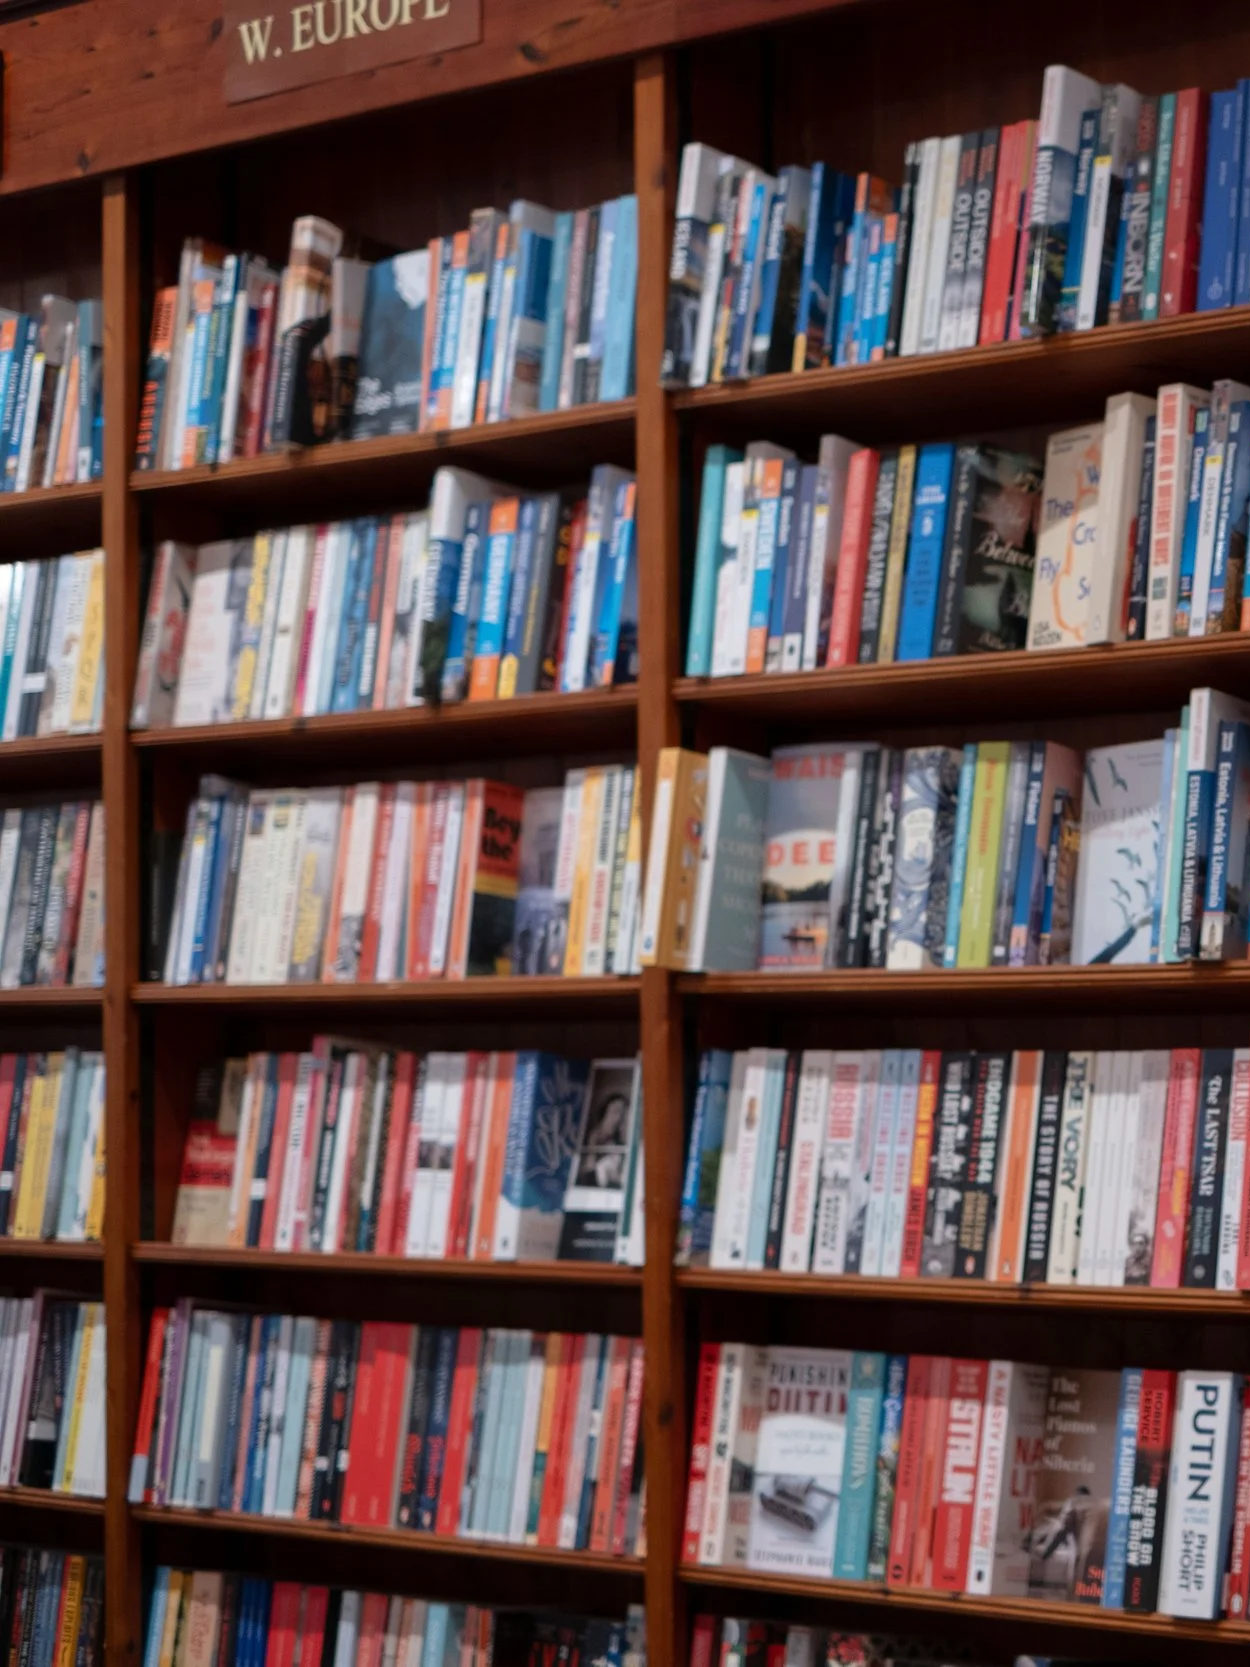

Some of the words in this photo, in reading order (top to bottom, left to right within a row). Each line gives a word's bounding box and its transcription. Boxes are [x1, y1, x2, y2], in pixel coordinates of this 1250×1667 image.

[238, 16, 283, 65] W.
[1029, 150, 1053, 225] NORWAY
[1024, 782, 1041, 825] Finland
[1037, 1126, 1056, 1175] STORY
[1060, 1116, 1083, 1192] VORY
[1202, 1108, 1221, 1153] LAST
[1198, 1153, 1220, 1197] TSAR
[1029, 1201, 1048, 1260] RUSSIA
[1187, 1384, 1219, 1501] PUTIN
[1114, 1435, 1137, 1516] SAUNDERS
[1178, 1530, 1195, 1592] SHORT
[1193, 1534, 1208, 1591] PHILIP
